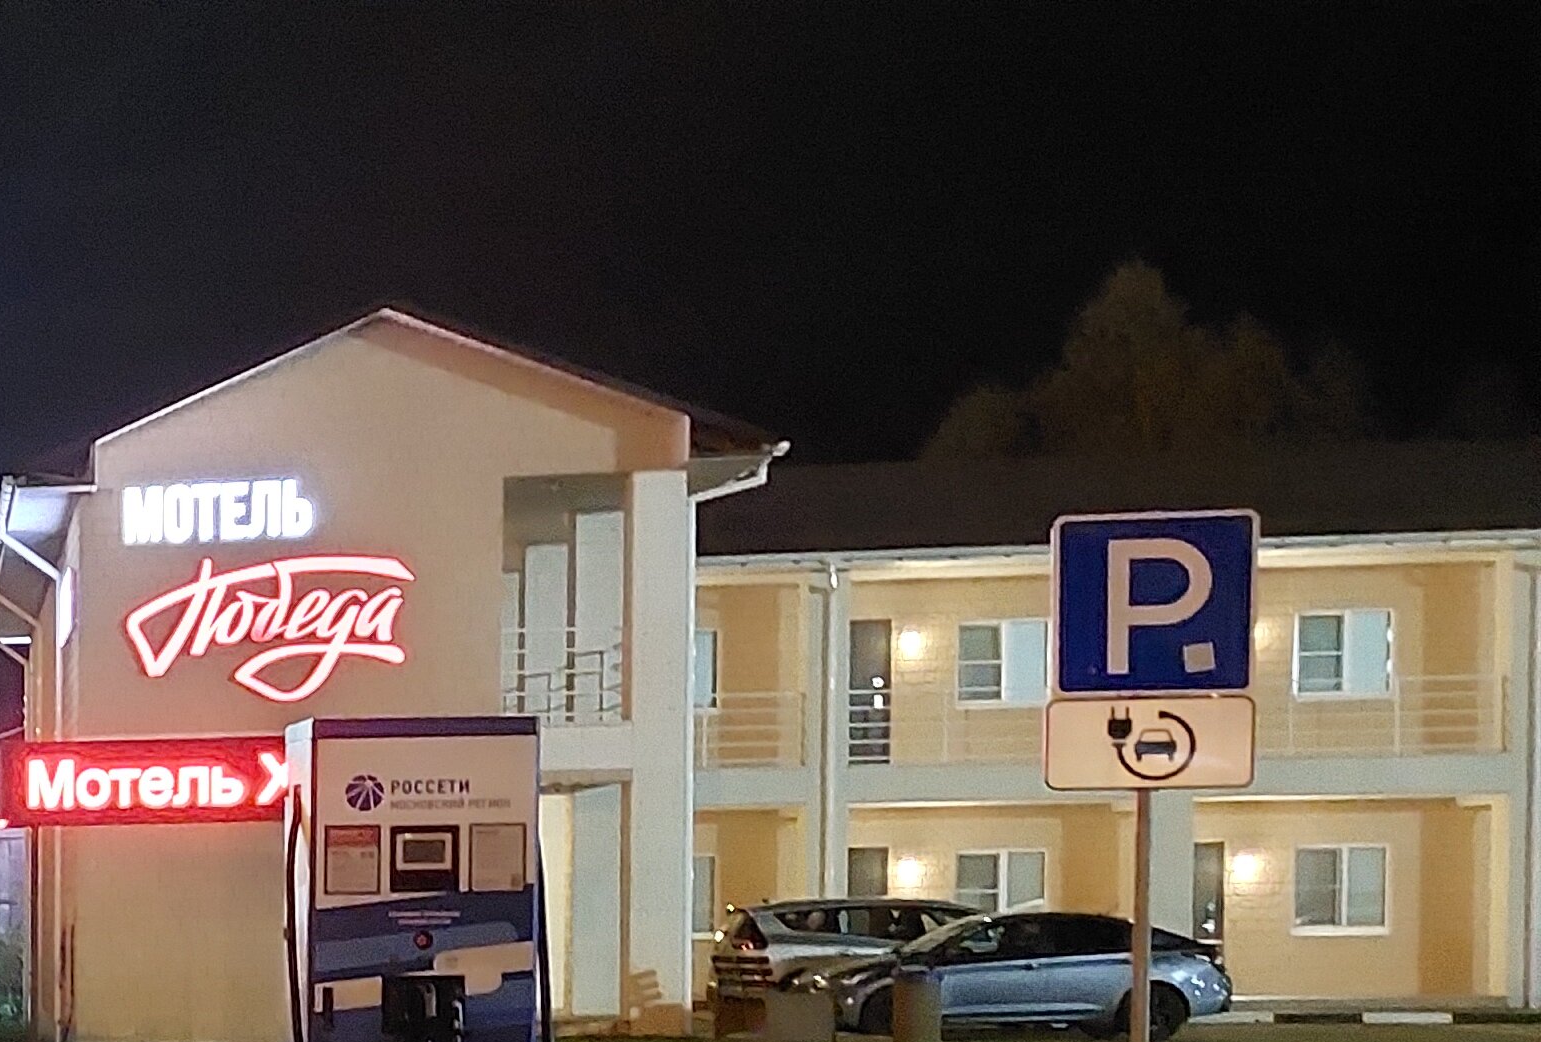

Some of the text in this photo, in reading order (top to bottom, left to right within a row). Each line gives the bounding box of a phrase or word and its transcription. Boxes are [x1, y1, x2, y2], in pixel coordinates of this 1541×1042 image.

[123, 478, 314, 545] МОТЕЛЬ
[126, 555, 415, 701] Победа
[1107, 538, 1213, 675] P
[28, 758, 246, 809] Мотель
[391, 779, 470, 794] РОССЕТИ
